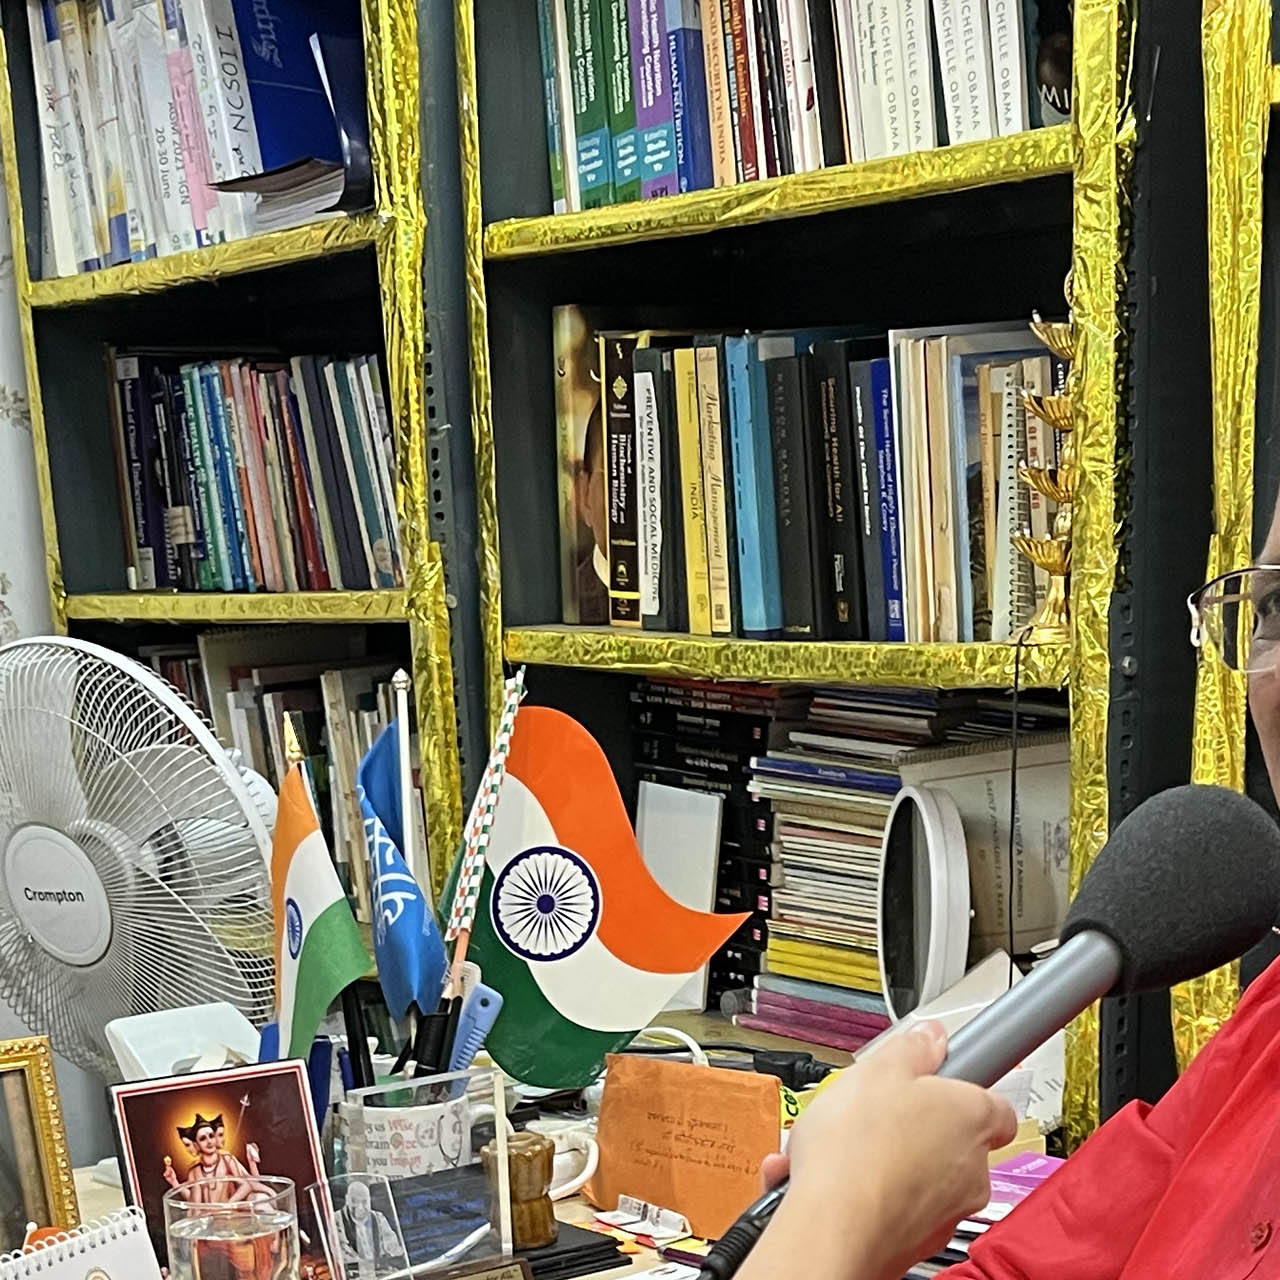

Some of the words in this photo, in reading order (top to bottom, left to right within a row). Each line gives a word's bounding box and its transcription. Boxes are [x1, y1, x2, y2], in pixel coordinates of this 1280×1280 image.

[995, 3, 1008, 63] CHELLE
[668, 35, 679, 87] HUMAN
[781, 40, 793, 88] ANEMIA
[879, 5, 893, 86] MICHELLE
[888, 92, 899, 152] OBAMA
[905, 0, 917, 79] MICHELLE
[911, 85, 922, 146] OBAMA
[941, 0, 956, 76] MICHELLE
[950, 81, 962, 141] OBAMA
[961, 0, 975, 65] ICHELLE
[968, 70, 980, 132] OBAMA
[1001, 67, 1012, 128] OBAMA
[154, 127, 168, 166] 20-30
[172, 140, 185, 171] 2021
[718, 124, 726, 165] INDIA
[159, 169, 170, 199] June
[645, 388, 655, 464] PREVENTIVE
[702, 384, 719, 461] Marketing
[882, 408, 890, 437] Seven
[188, 421, 201, 466] HEALTH
[611, 433, 619, 478] Human
[831, 437, 841, 478] Health
[884, 440, 892, 470] Habits
[617, 433, 627, 509] Biochemistry
[648, 467, 656, 494] AND
[878, 450, 886, 488] Stephen
[611, 479, 620, 523] Biology
[691, 482, 699, 520] INDIA
[834, 482, 842, 500] for
[886, 484, 894, 513] Highly
[649, 497, 658, 539] SOCIAL
[705, 465, 722, 559] Management
[835, 505, 844, 522] All
[880, 503, 888, 531] Covey
[889, 517, 897, 556] Effective
[650, 542, 659, 601] MEDICINE
[891, 559, 899, 590] People
[23, 886, 86, 905] Crompton
